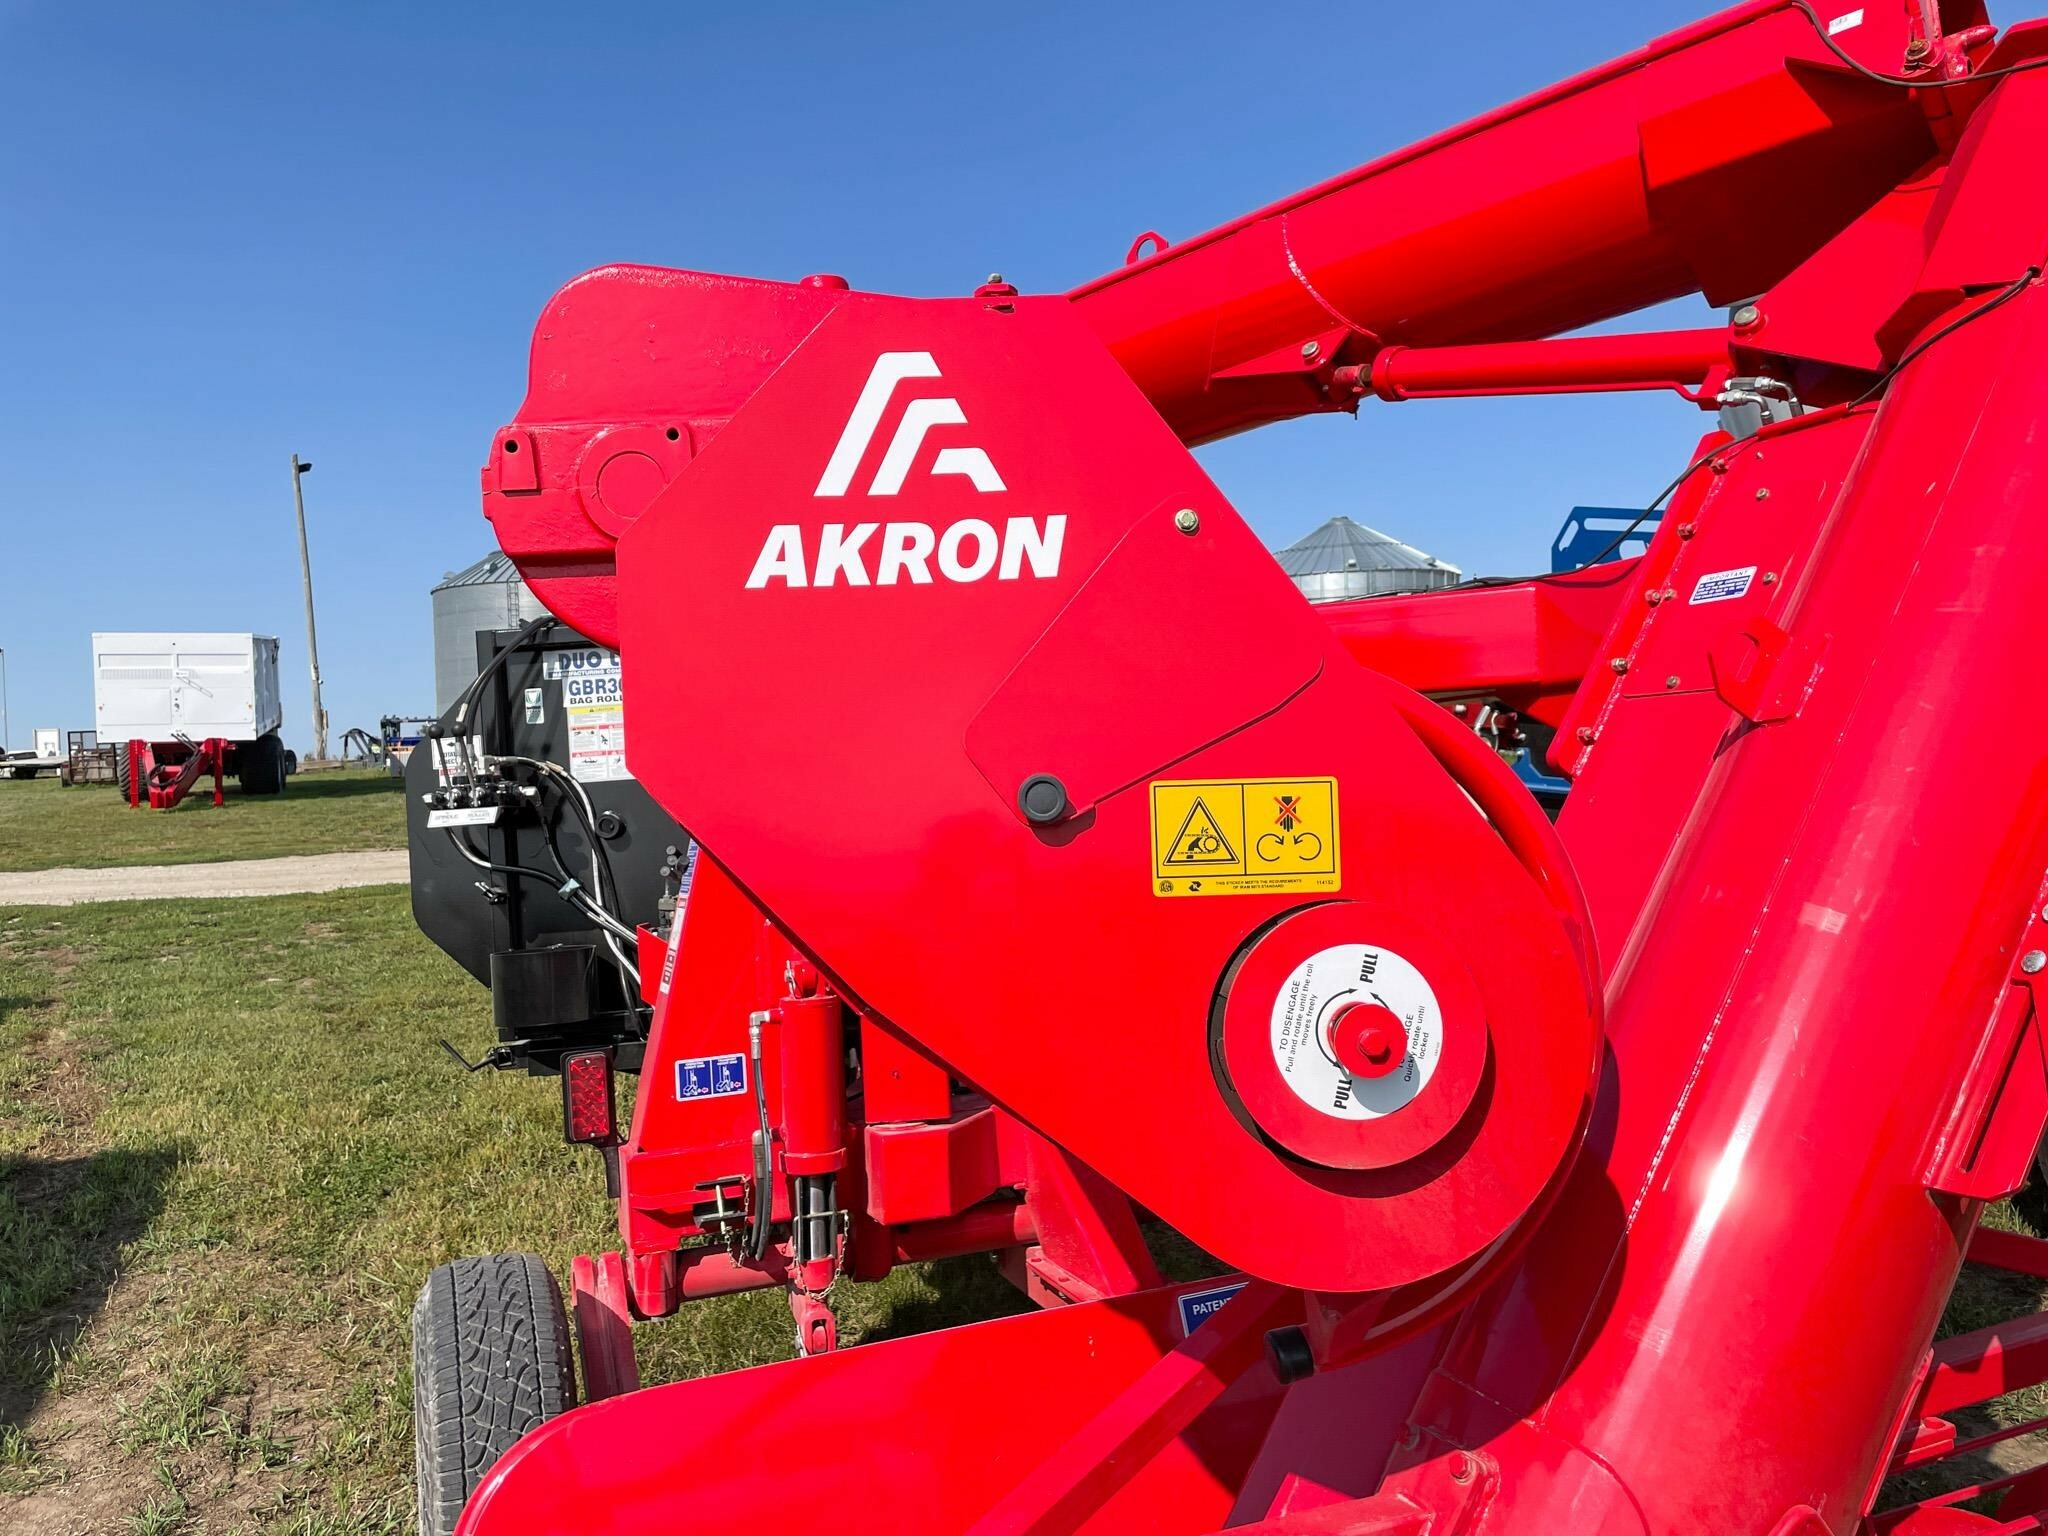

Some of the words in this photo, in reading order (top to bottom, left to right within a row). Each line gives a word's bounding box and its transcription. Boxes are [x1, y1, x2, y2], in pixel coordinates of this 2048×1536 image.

[744, 514, 1068, 589] AKRON
[559, 651, 602, 670] DUO
[1307, 963, 1315, 977] roll
[1359, 953, 1379, 984] PULL
[1303, 977, 1312, 992] the
[1283, 980, 1301, 1036] DISENGAGE
[1299, 993, 1308, 1012] until
[1293, 1012, 1304, 1038] rotate
[1302, 1018, 1312, 1046] moves
[1308, 993, 1319, 1018] freely
[1279, 1037, 1289, 1050] TO
[1290, 1039, 1298, 1055] and
[1403, 1052, 1417, 1082] Quickly
[1412, 1025, 1422, 1050] rotate
[1417, 1005, 1426, 1024] until
[1418, 1032, 1429, 1060] locked
[1285, 1056, 1295, 1073] Pull
[1333, 1079, 1353, 1110] PULL
